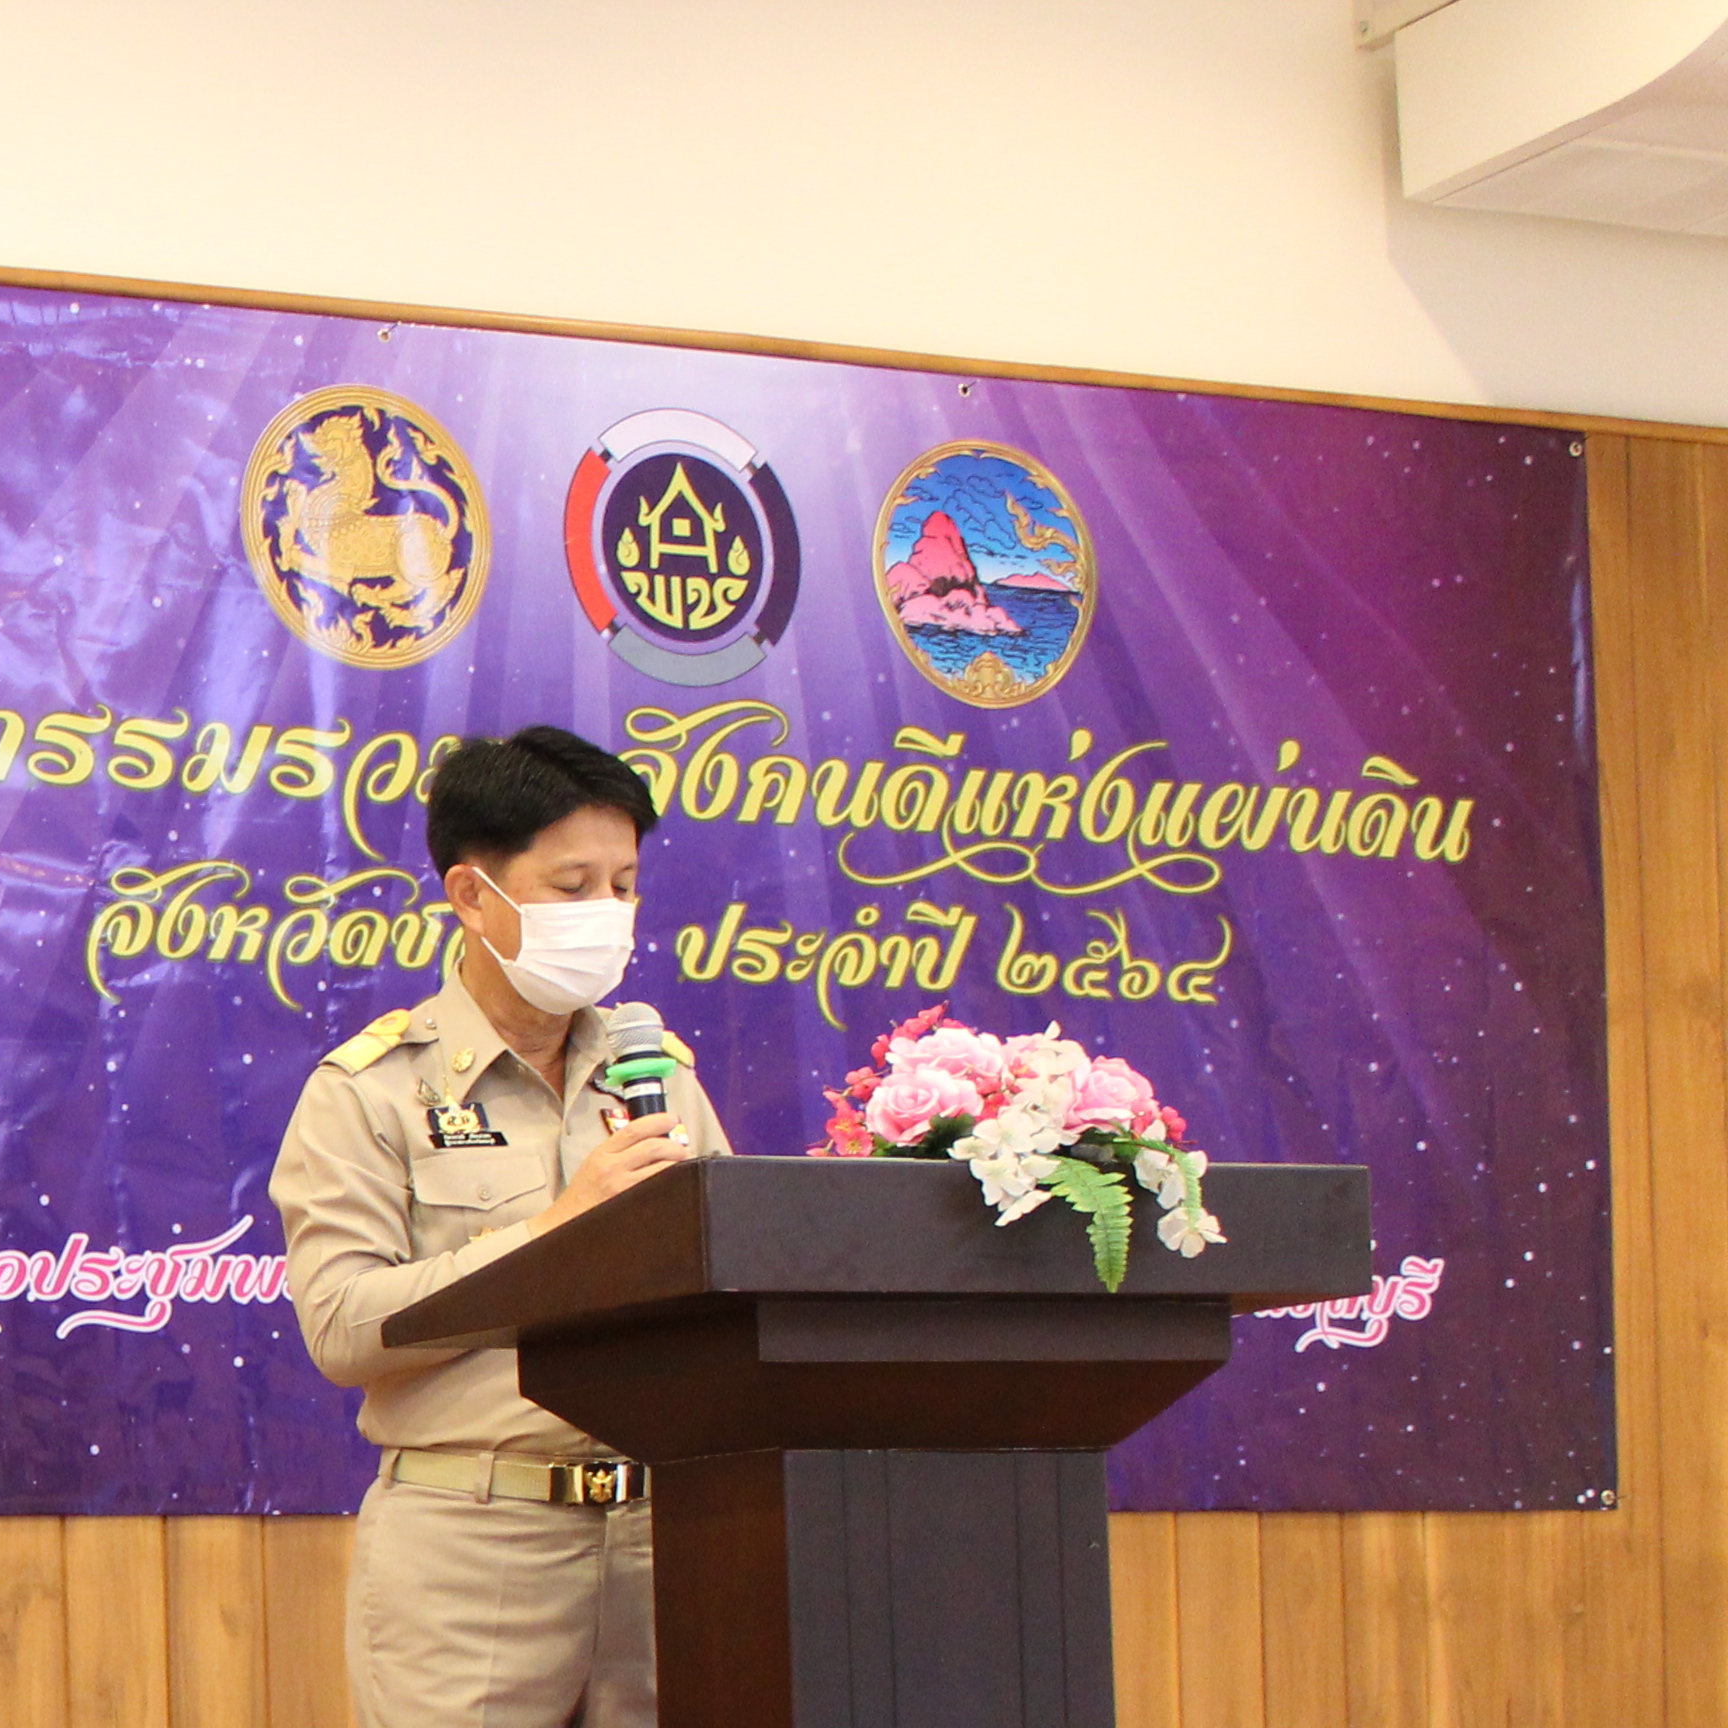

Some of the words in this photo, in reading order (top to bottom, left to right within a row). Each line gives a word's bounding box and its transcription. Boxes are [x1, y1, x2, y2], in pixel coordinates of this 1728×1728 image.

[86, 860, 467, 1012] จังหวัดช
[675, 900, 979, 1034] ประจำปี
[995, 902, 1234, 1008] ๒๕๖๔
